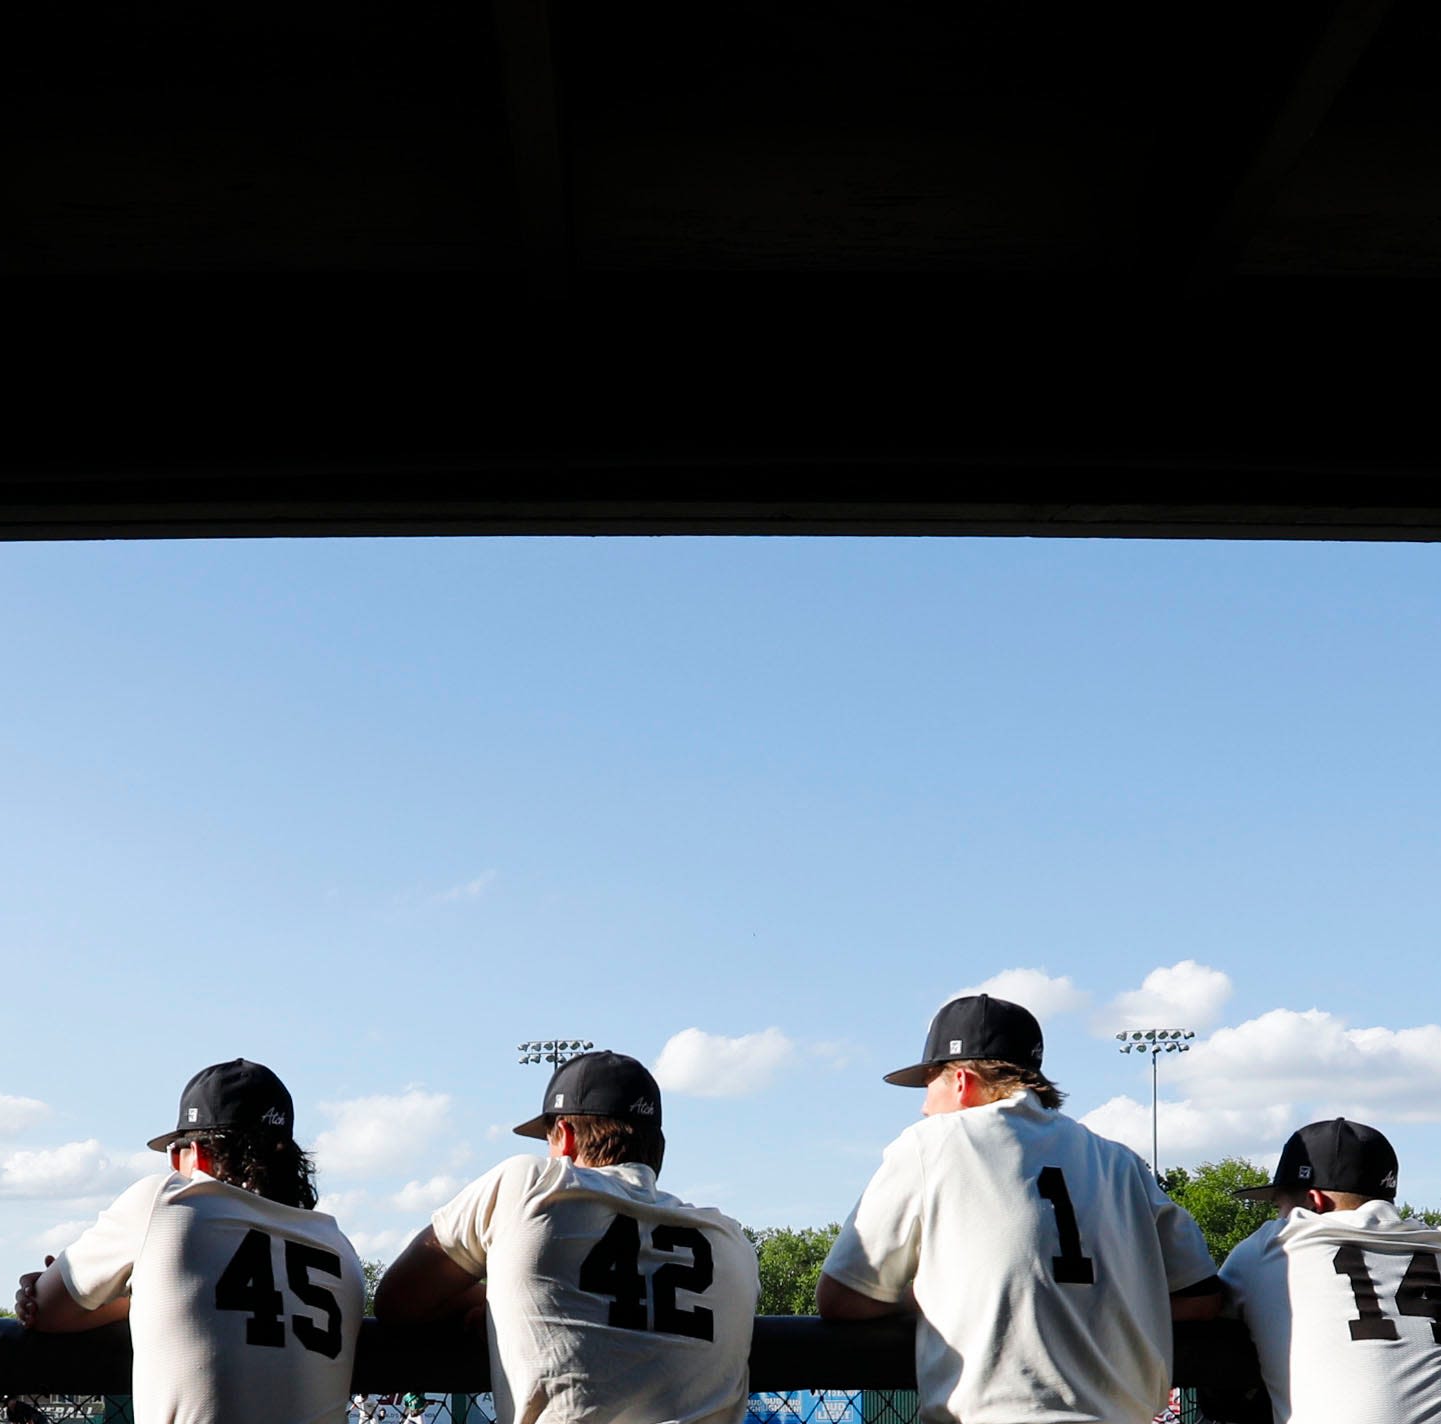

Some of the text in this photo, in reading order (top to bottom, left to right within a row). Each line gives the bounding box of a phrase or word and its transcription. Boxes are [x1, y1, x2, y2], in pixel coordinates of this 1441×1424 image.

[578, 1213, 714, 1342] 42
[1039, 1166, 1094, 1284] 1
[215, 1228, 341, 1360] 45
